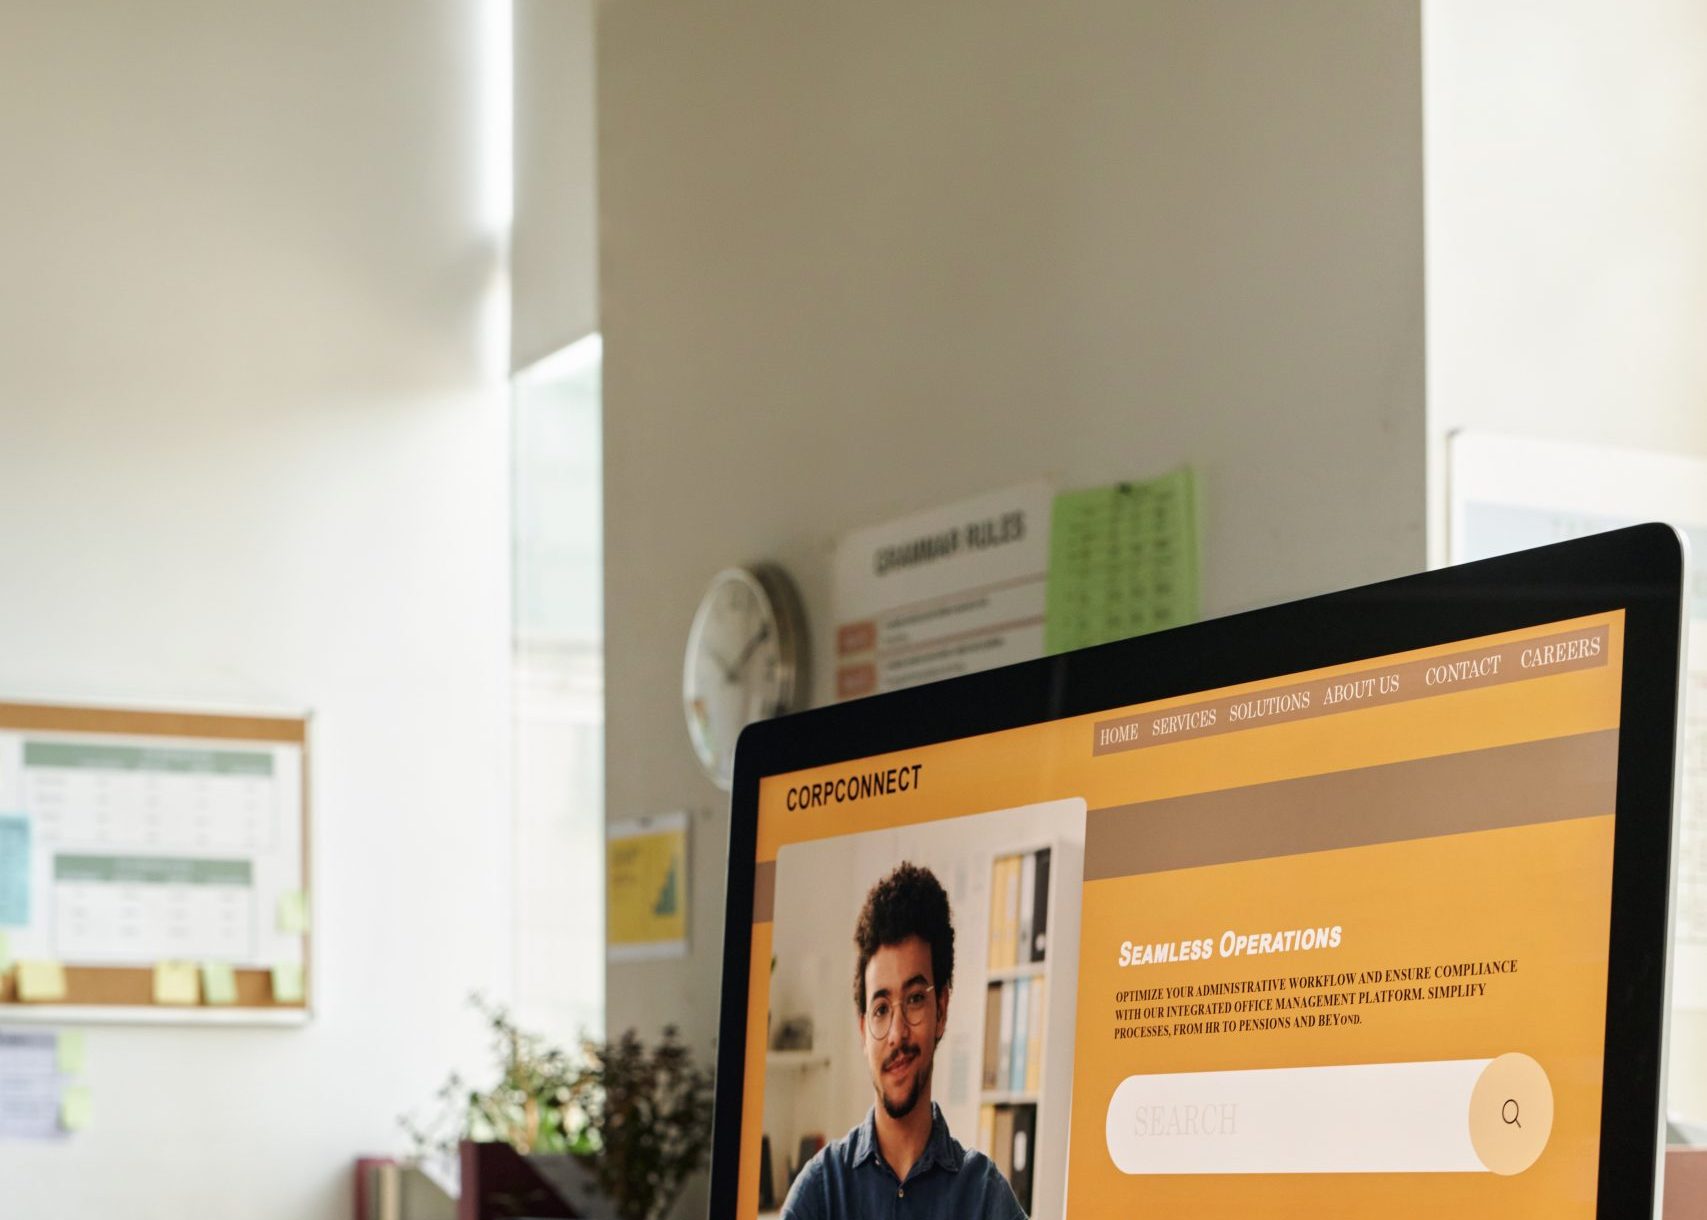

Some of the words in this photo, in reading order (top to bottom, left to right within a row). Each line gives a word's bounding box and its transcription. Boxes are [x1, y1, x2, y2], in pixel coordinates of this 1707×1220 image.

[875, 527, 958, 576] GRAMMAR
[966, 509, 1026, 549] RULES
[1099, 723, 1139, 746] HOME
[1152, 708, 1217, 737] SERVICES
[1229, 691, 1310, 723] SOLUTIONS
[1323, 679, 1377, 706] ABOUT
[1379, 675, 1399, 694] US
[1425, 655, 1501, 686] CONTACT
[1520, 637, 1600, 669] CAREERS
[786, 764, 922, 811] CORPCONNECT
[1115, 987, 1164, 1003] OPTIMIZE
[1166, 985, 1194, 999] YOUR
[1196, 978, 1286, 997] ADMINISTRATIVE
[1289, 973, 1357, 989] WORKFLOW
[1358, 970, 1382, 985] AND
[1385, 966, 1431, 983] ENSURE
[1434, 959, 1518, 979] COMPLIANCE
[1115, 1007, 1141, 1021] WITH
[1143, 1006, 1164, 1019] OUR
[1166, 1001, 1232, 1018] INTEGRATED
[1234, 998, 1272, 1013] OFFICE
[1275, 993, 1356, 1010] MANAGEMENT
[1358, 987, 1425, 1005] PLATFORM.
[1427, 983, 1487, 999] SIMPLIFY
[1114, 1025, 1171, 1040] PROCESSES,
[1173, 1022, 1203, 1036] FROM
[1205, 1021, 1220, 1034] HR
[1222, 1020, 1237, 1033] TO
[1239, 1016, 1291, 1032] PENSIONS
[1293, 1015, 1316, 1028] AND
[1133, 1102, 1239, 1140] SEARCH
